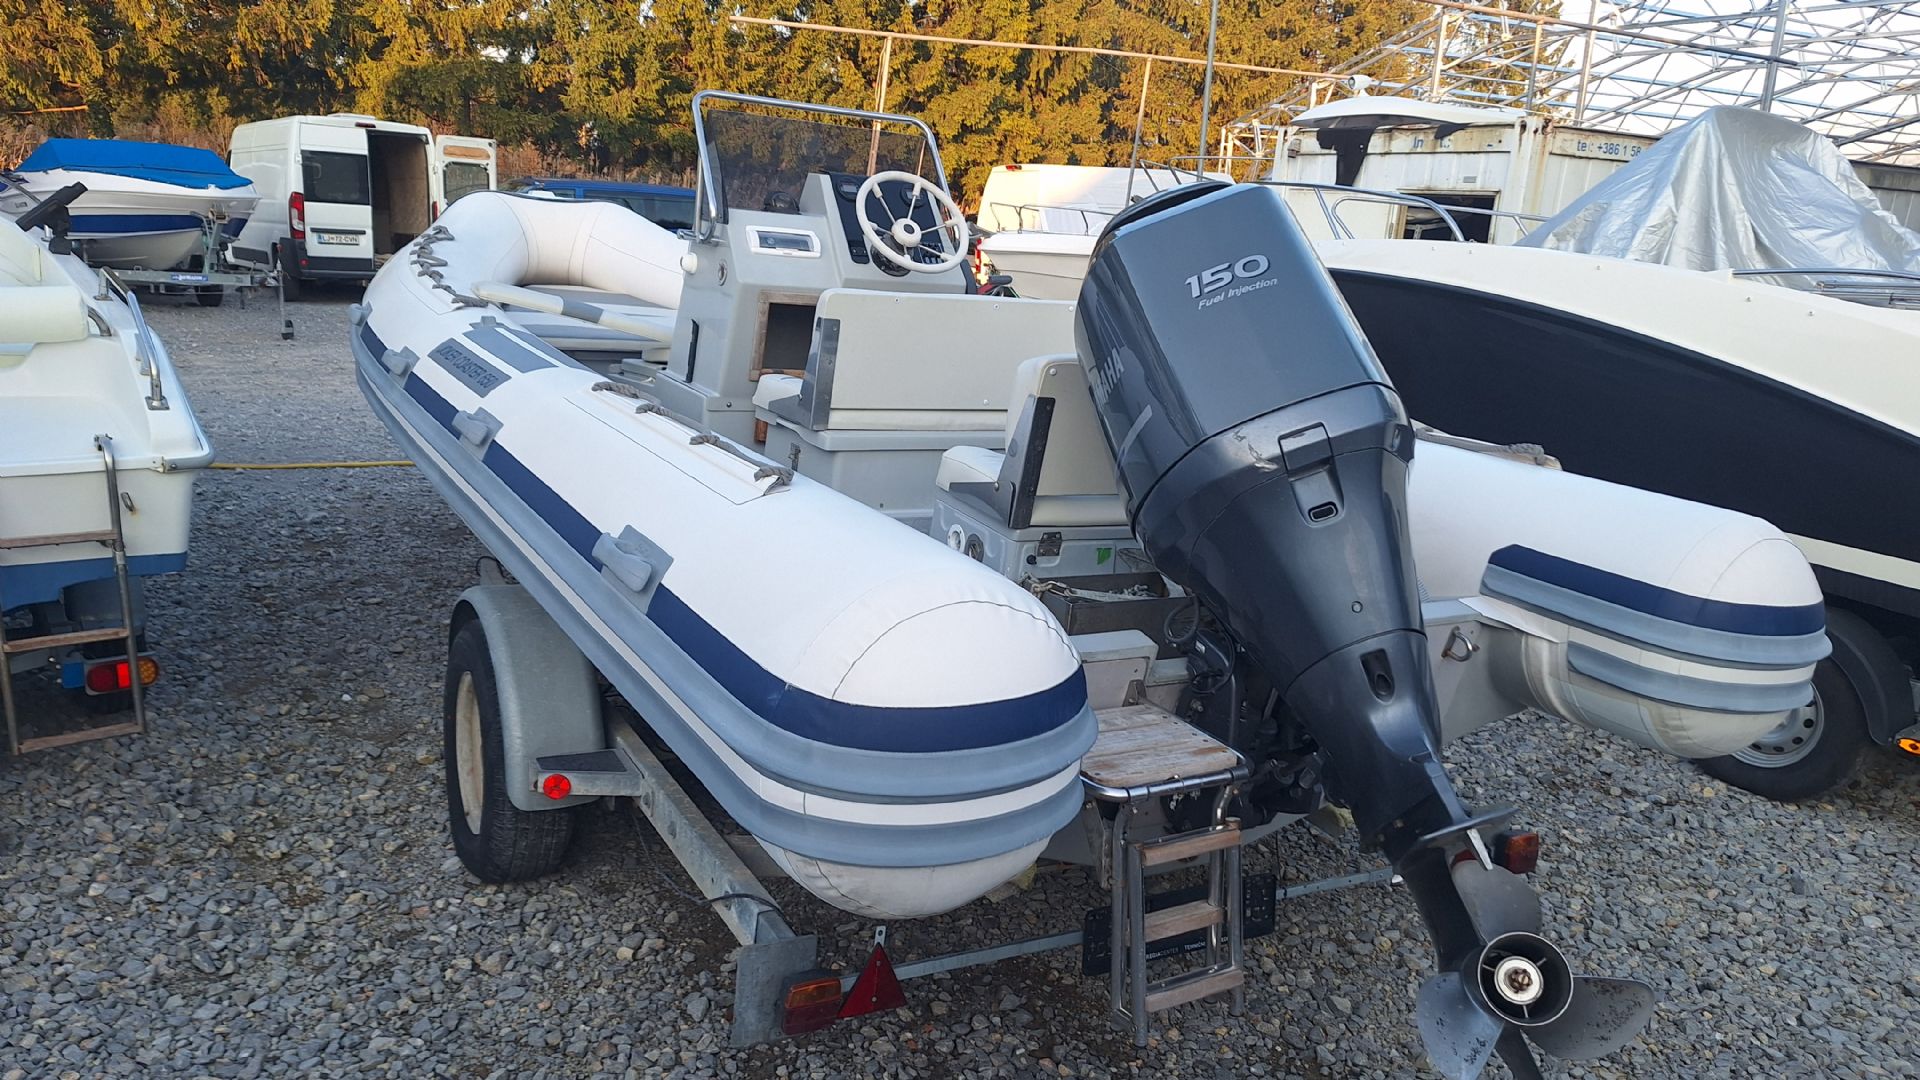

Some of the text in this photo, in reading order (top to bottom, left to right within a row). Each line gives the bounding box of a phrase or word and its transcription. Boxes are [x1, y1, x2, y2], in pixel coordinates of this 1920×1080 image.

[1597, 142, 1620, 155] +386
[1622, 144, 1629, 157] 1
[1185, 254, 1270, 299] 150
[1198, 278, 1278, 311] Fuel Injection
